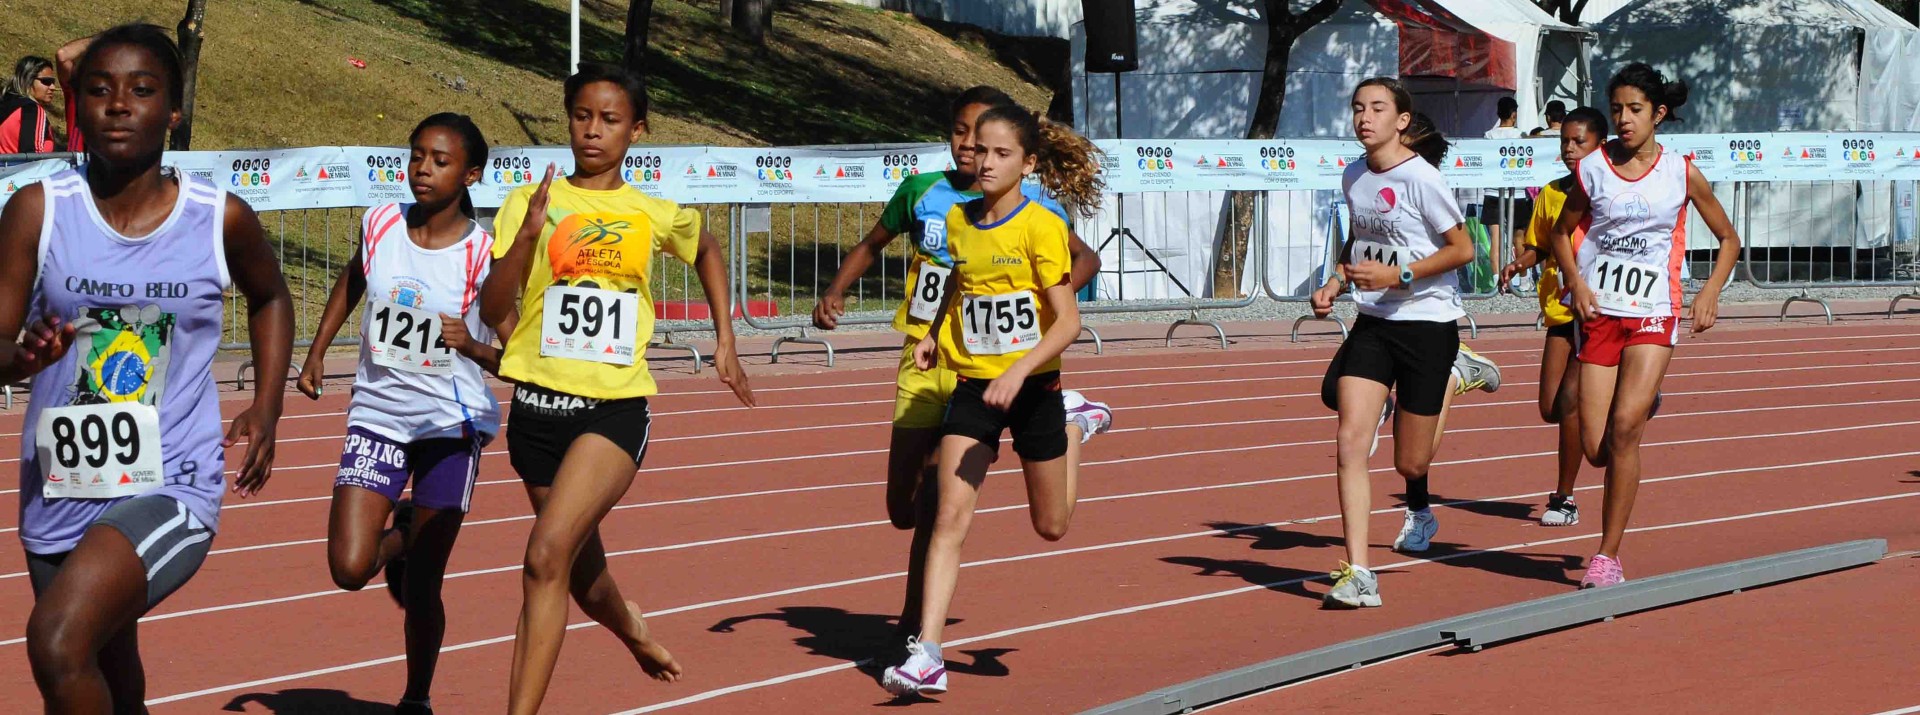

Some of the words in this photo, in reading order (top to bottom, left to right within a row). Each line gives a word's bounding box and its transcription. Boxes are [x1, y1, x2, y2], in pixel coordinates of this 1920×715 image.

[1137, 146, 1172, 157] JEMG
[1499, 146, 1533, 156] JEMG
[1730, 140, 1761, 150] JEMG
[1260, 147, 1294, 158] JEMG
[232, 158, 270, 171] JEMG
[367, 155, 402, 169] JEMG
[493, 156, 530, 169] JEMG
[625, 156, 661, 168] JEMG
[756, 156, 791, 168] JEMG
[884, 154, 918, 166] JEMG
[1370, 216, 1401, 233] JOSÉ
[924, 218, 945, 250] 5
[577, 248, 622, 261] ATLETA
[992, 255, 1022, 264] Lavras
[586, 259, 621, 269] ESCOLA
[1598, 261, 1659, 298] 1107
[65, 276, 134, 298] CAMPO
[146, 282, 188, 298] BELO
[558, 294, 621, 339] 591
[965, 296, 1034, 334] 1755
[376, 306, 450, 355] 1214
[52, 411, 140, 468] 899
[343, 434, 405, 468] SPRING
[355, 456, 377, 471] OF
